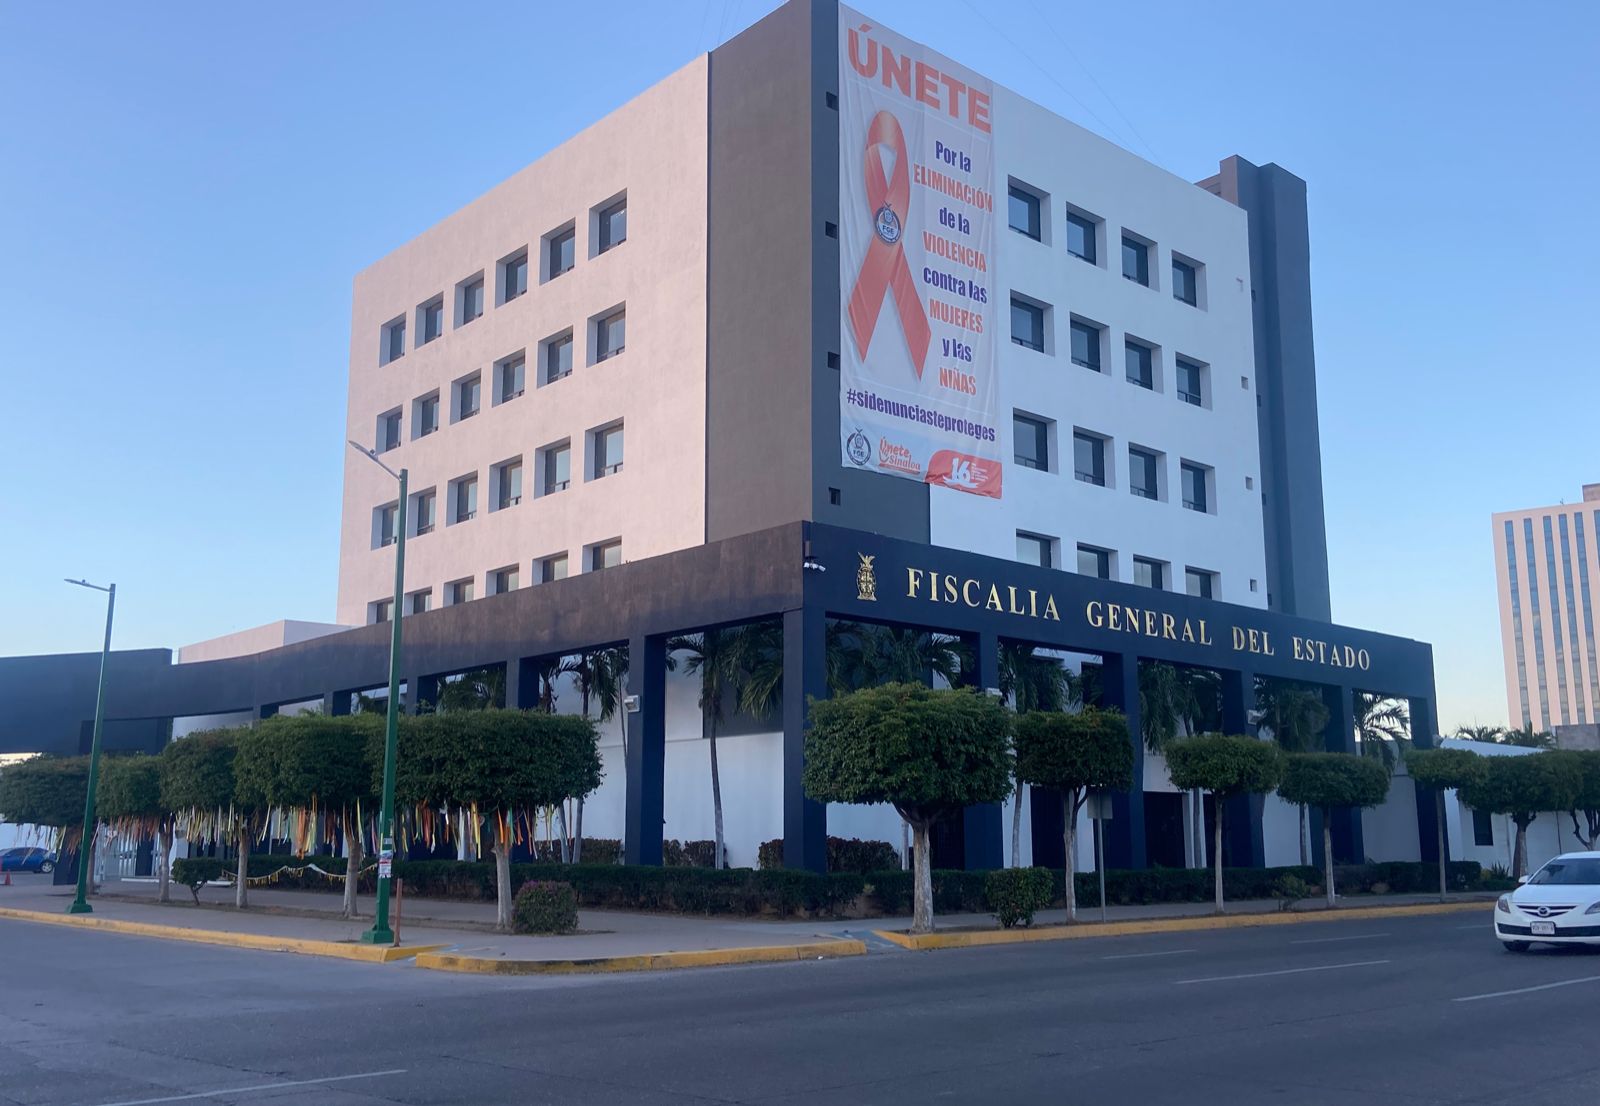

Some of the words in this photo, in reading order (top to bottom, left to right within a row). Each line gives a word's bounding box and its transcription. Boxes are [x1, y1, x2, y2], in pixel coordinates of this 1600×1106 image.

[848, 23, 991, 134] ÚNETE
[935, 140, 957, 167] Por
[960, 151, 971, 173] la
[913, 163, 993, 213] ELIMINACIÓN
[939, 207, 955, 229] de
[958, 213, 970, 235] la
[923, 231, 986, 273] VIOLENCIA
[923, 267, 965, 297] contra
[968, 280, 987, 304] las
[929, 298, 983, 334] MUJERES
[942, 338, 949, 357] y
[952, 338, 972, 362] las
[939, 367, 977, 396] NIÑAS
[846, 388, 996, 442] #sidenunciasteproteges
[880, 436, 909, 458] Únete
[889, 454, 921, 471] Sinaloa
[906, 567, 1061, 622] FISCALIA
[1086, 601, 1213, 647] GENERAL
[1232, 626, 1275, 656] DEL
[1292, 636, 1371, 671] ESTADO
